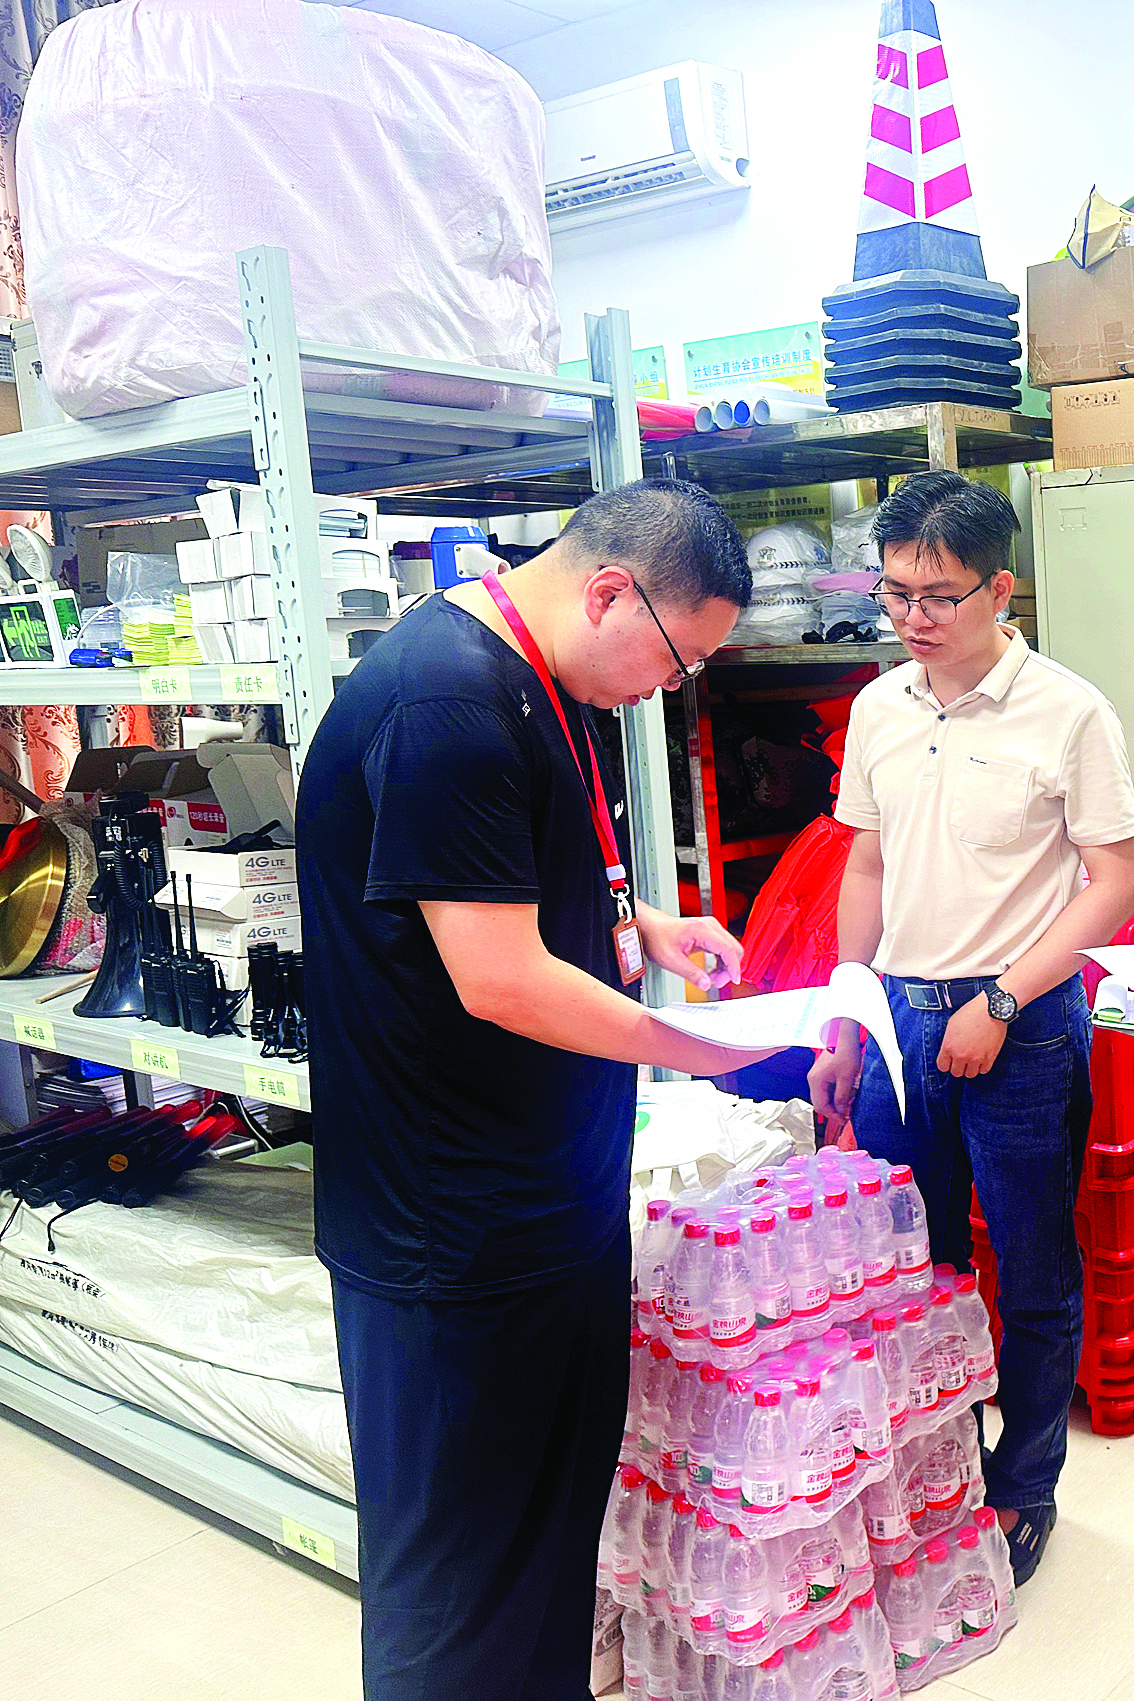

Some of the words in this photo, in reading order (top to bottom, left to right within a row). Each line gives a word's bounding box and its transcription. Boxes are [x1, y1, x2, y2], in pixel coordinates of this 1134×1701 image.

[693, 348, 812, 379] 计划生育协会宣传培训制度
[151, 678, 178, 694] 明白卡
[234, 676, 263, 693] 责任卡
[245, 856, 270, 868] 4G
[271, 858, 286, 867] LTE
[252, 892, 277, 904] 4G
[278, 893, 292, 902] LTE
[247, 926, 272, 939] 4G
[272, 927, 288, 935] LTE
[143, 1052, 169, 1070] 对讲机
[257, 1077, 286, 1097] 手电筒
